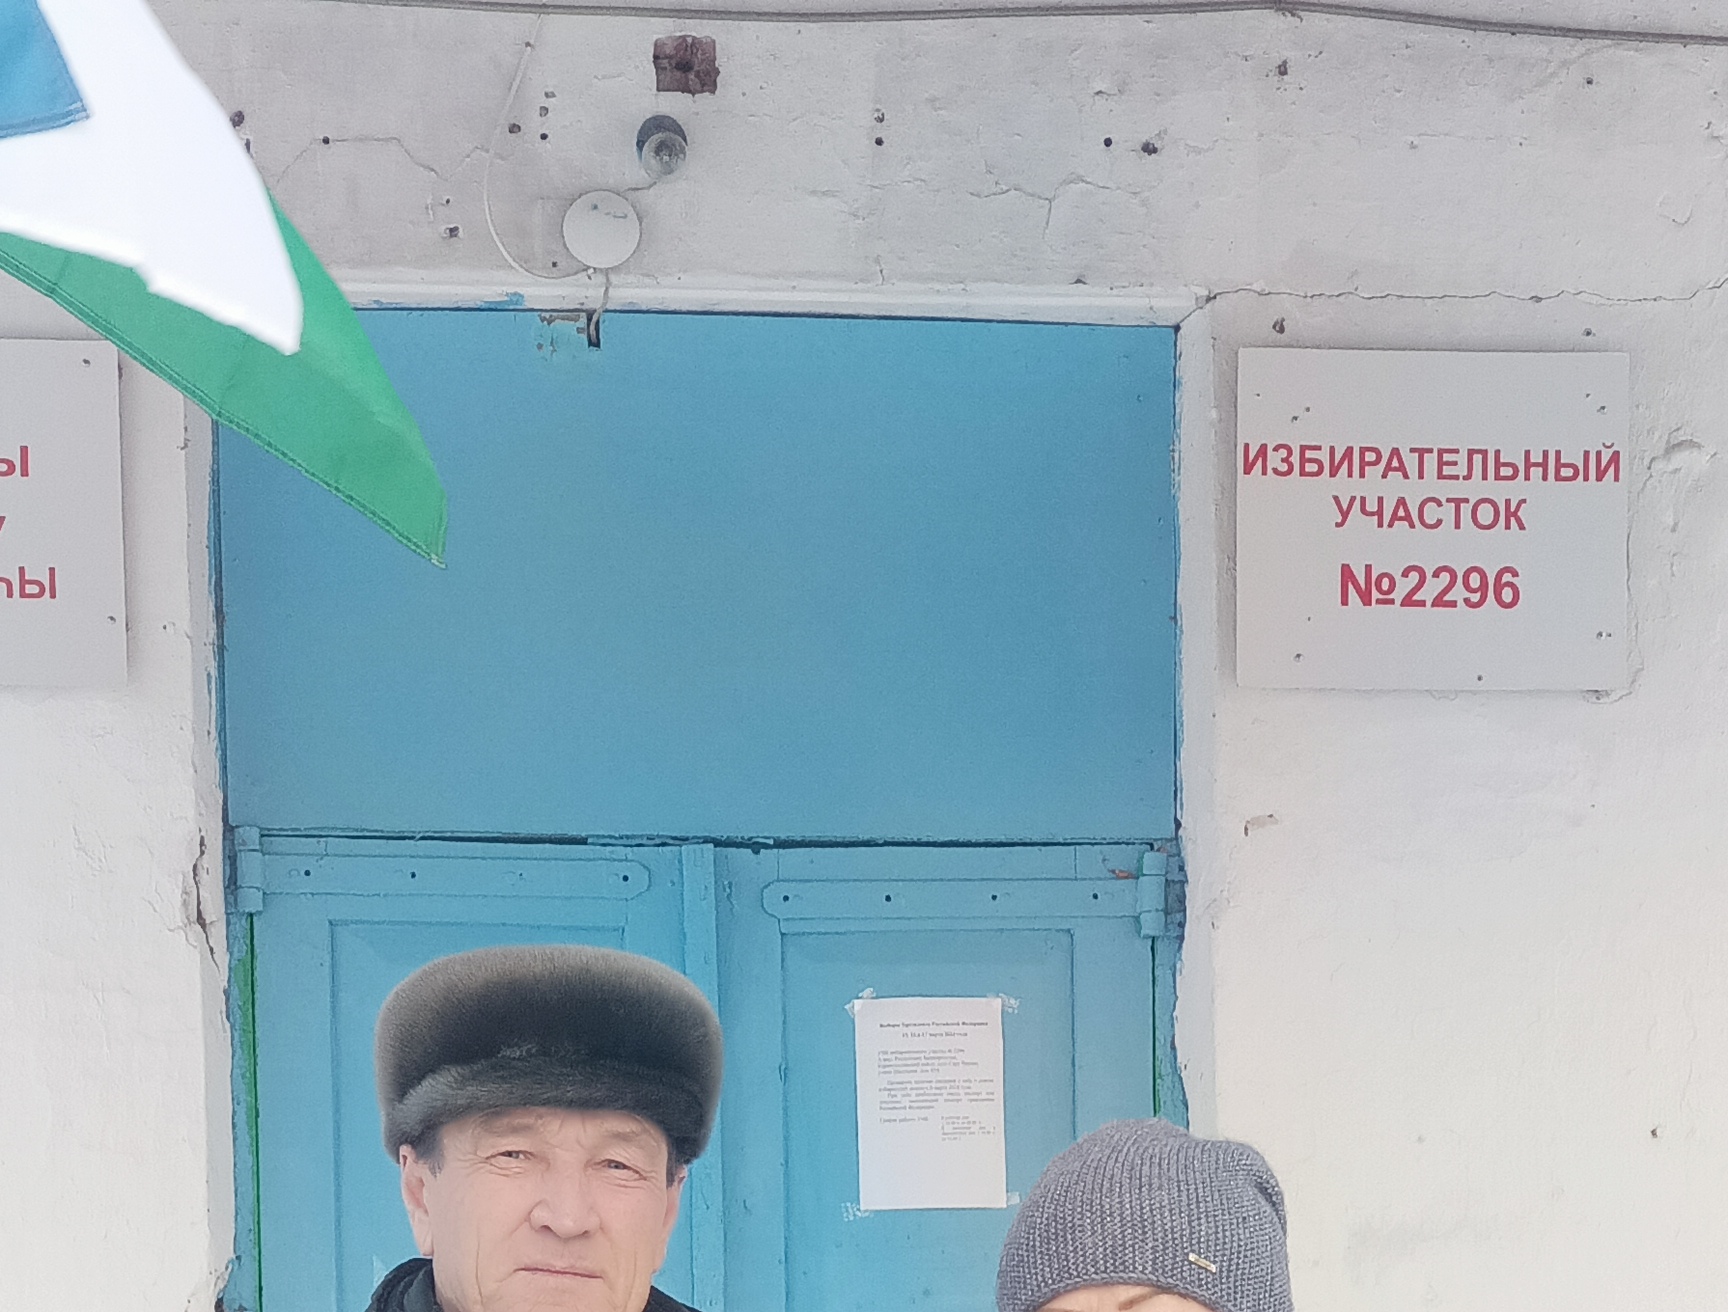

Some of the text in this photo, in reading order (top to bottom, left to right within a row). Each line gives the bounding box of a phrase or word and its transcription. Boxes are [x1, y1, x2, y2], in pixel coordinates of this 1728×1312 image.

[1242, 443, 1621, 483] ИЗБИРАТЕЛЬНЫЙ
[1332, 495, 1526, 531] УЧАСТОК
[1340, 563, 1521, 609] №2296
